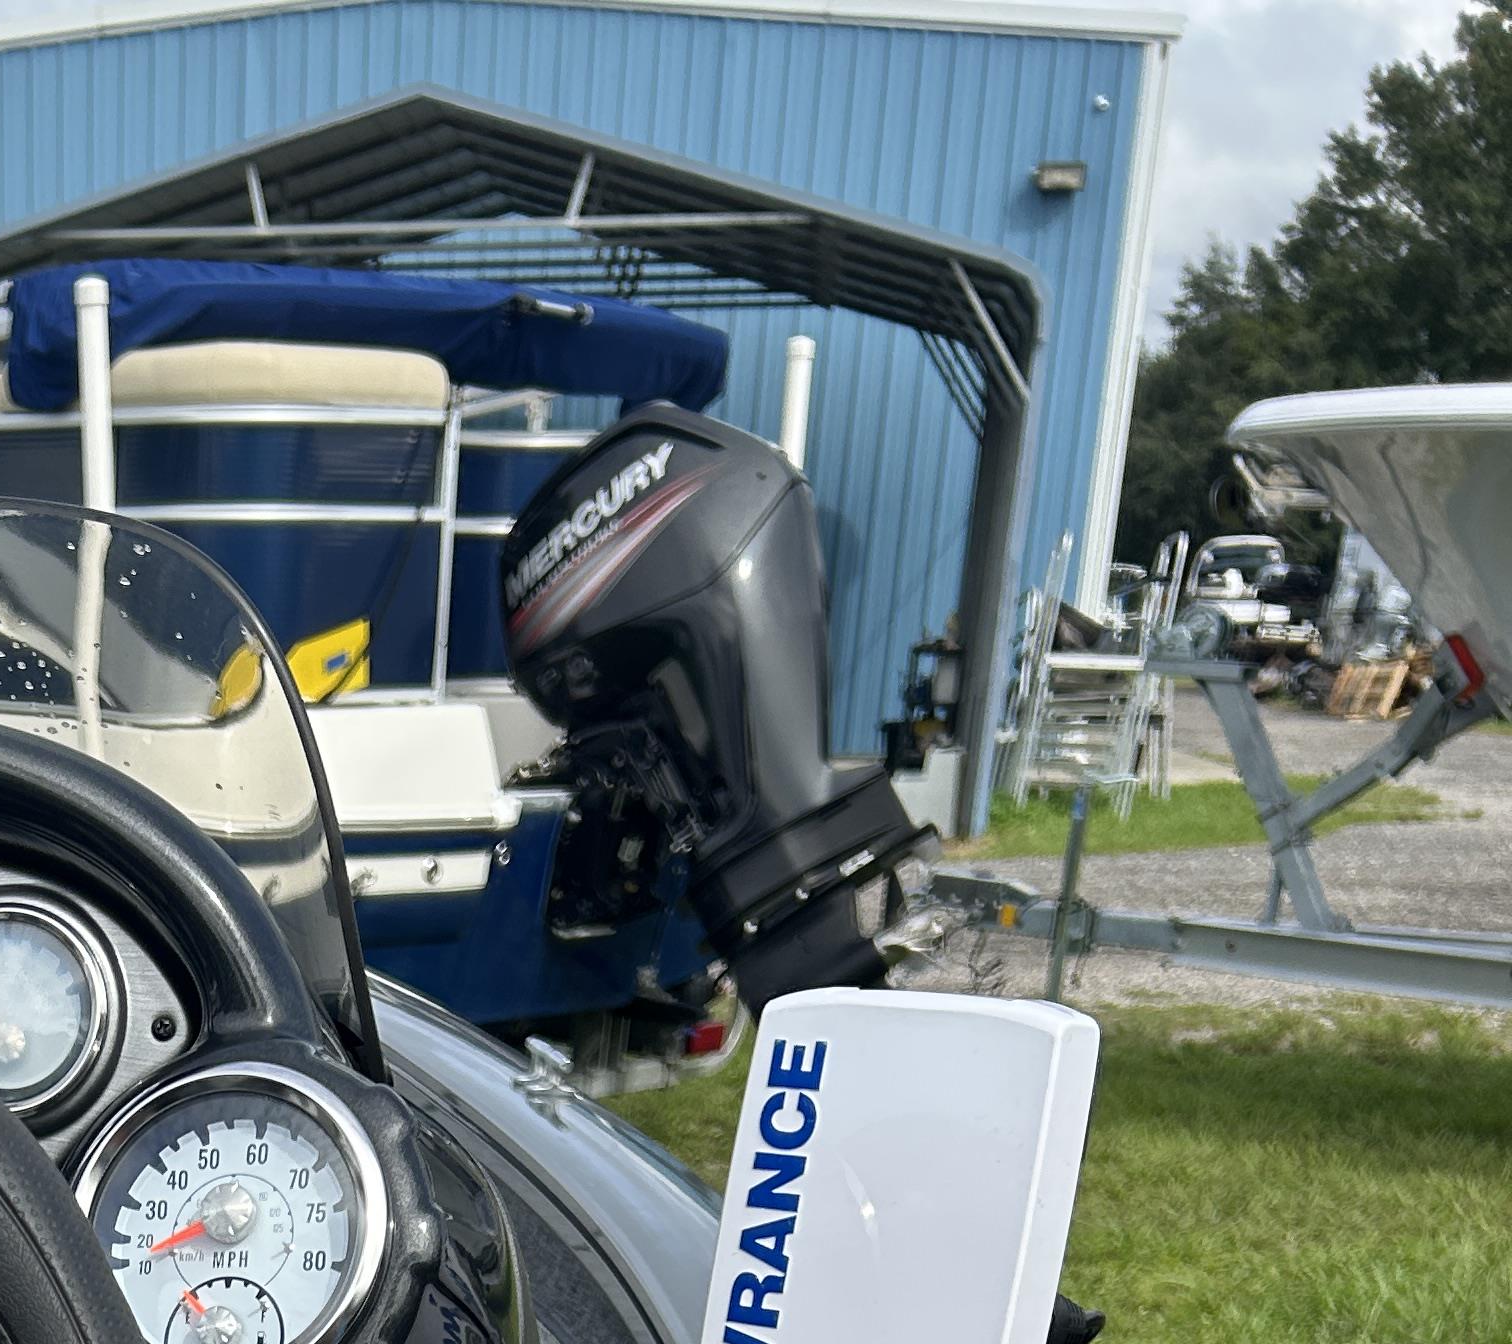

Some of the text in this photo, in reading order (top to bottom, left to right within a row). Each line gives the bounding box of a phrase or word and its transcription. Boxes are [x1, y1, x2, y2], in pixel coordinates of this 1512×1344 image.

[504, 440, 675, 609] MERCURY
[198, 1148, 220, 1170] 50
[246, 1143, 269, 1165] 60
[166, 1170, 188, 1191] 40
[289, 1167, 310, 1190] 70
[145, 1200, 168, 1221] 30
[306, 1202, 327, 1224] 75
[137, 1234, 154, 1249] 20
[179, 1248, 205, 1262] km/h
[212, 1250, 249, 1269] MPH
[302, 1250, 326, 1271] 80
[138, 1260, 152, 1275] 10
